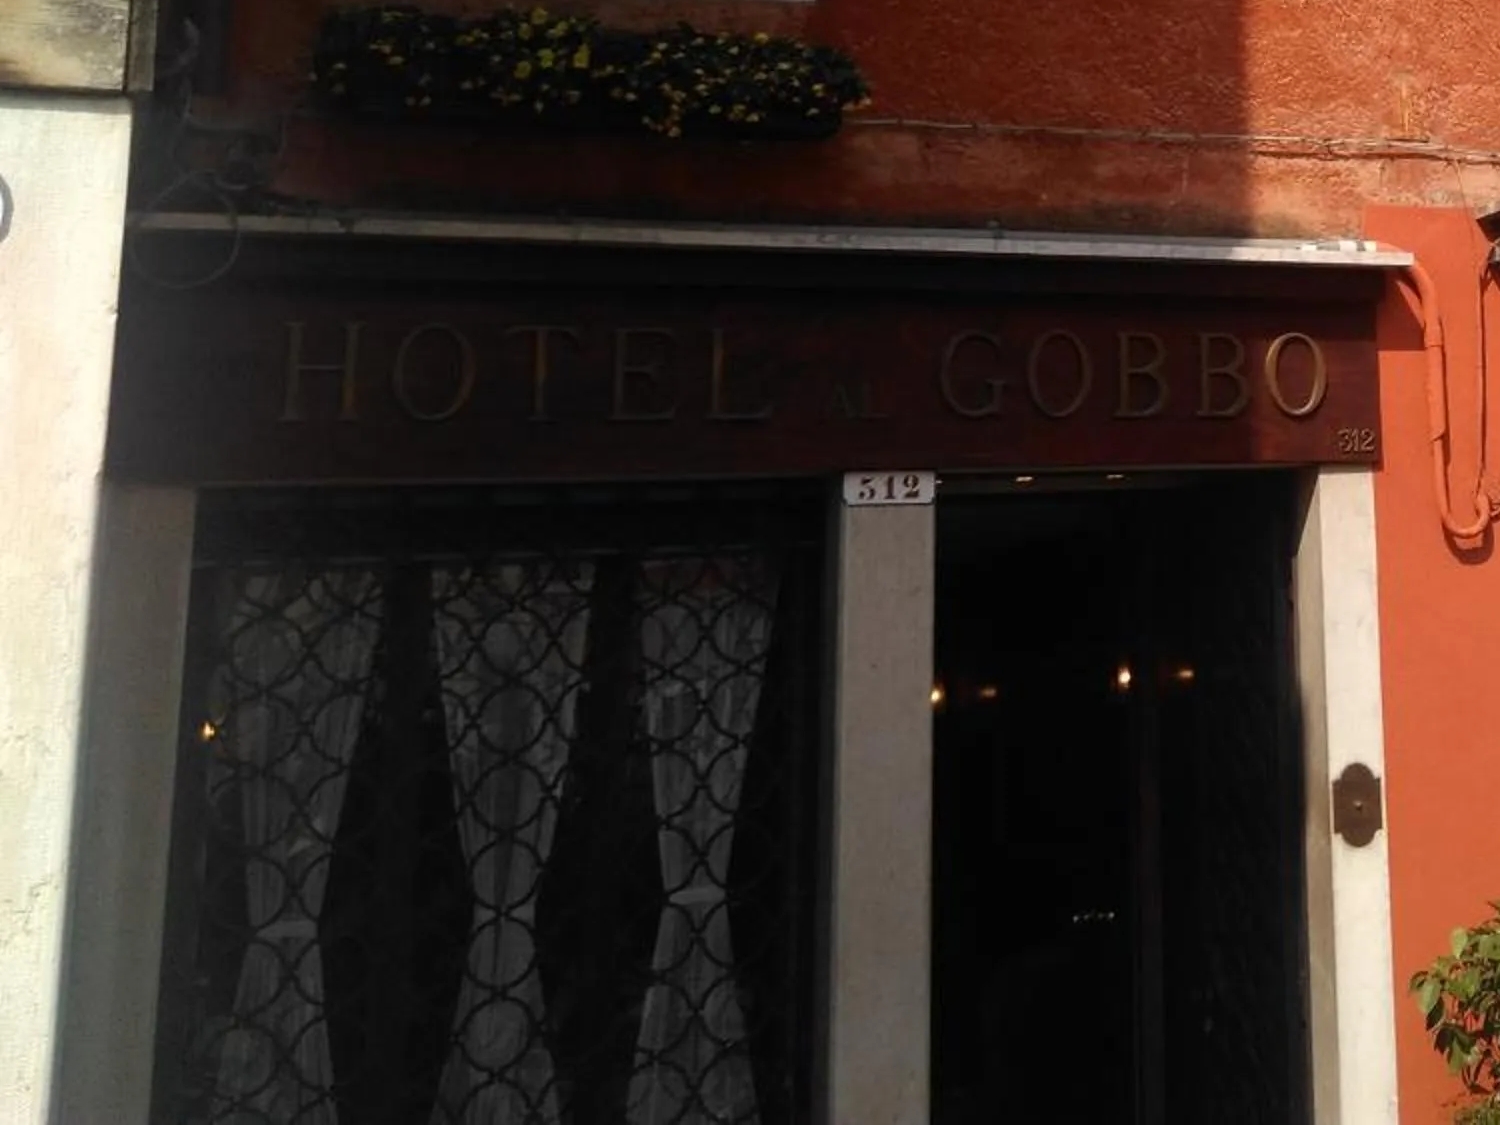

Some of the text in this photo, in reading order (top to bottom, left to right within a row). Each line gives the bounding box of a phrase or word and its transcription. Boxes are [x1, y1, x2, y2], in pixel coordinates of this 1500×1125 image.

[278, 320, 774, 423] HOTEL
[939, 329, 1328, 419] GOBBO
[1337, 428, 1375, 453] 312
[858, 474, 920, 501] 312
